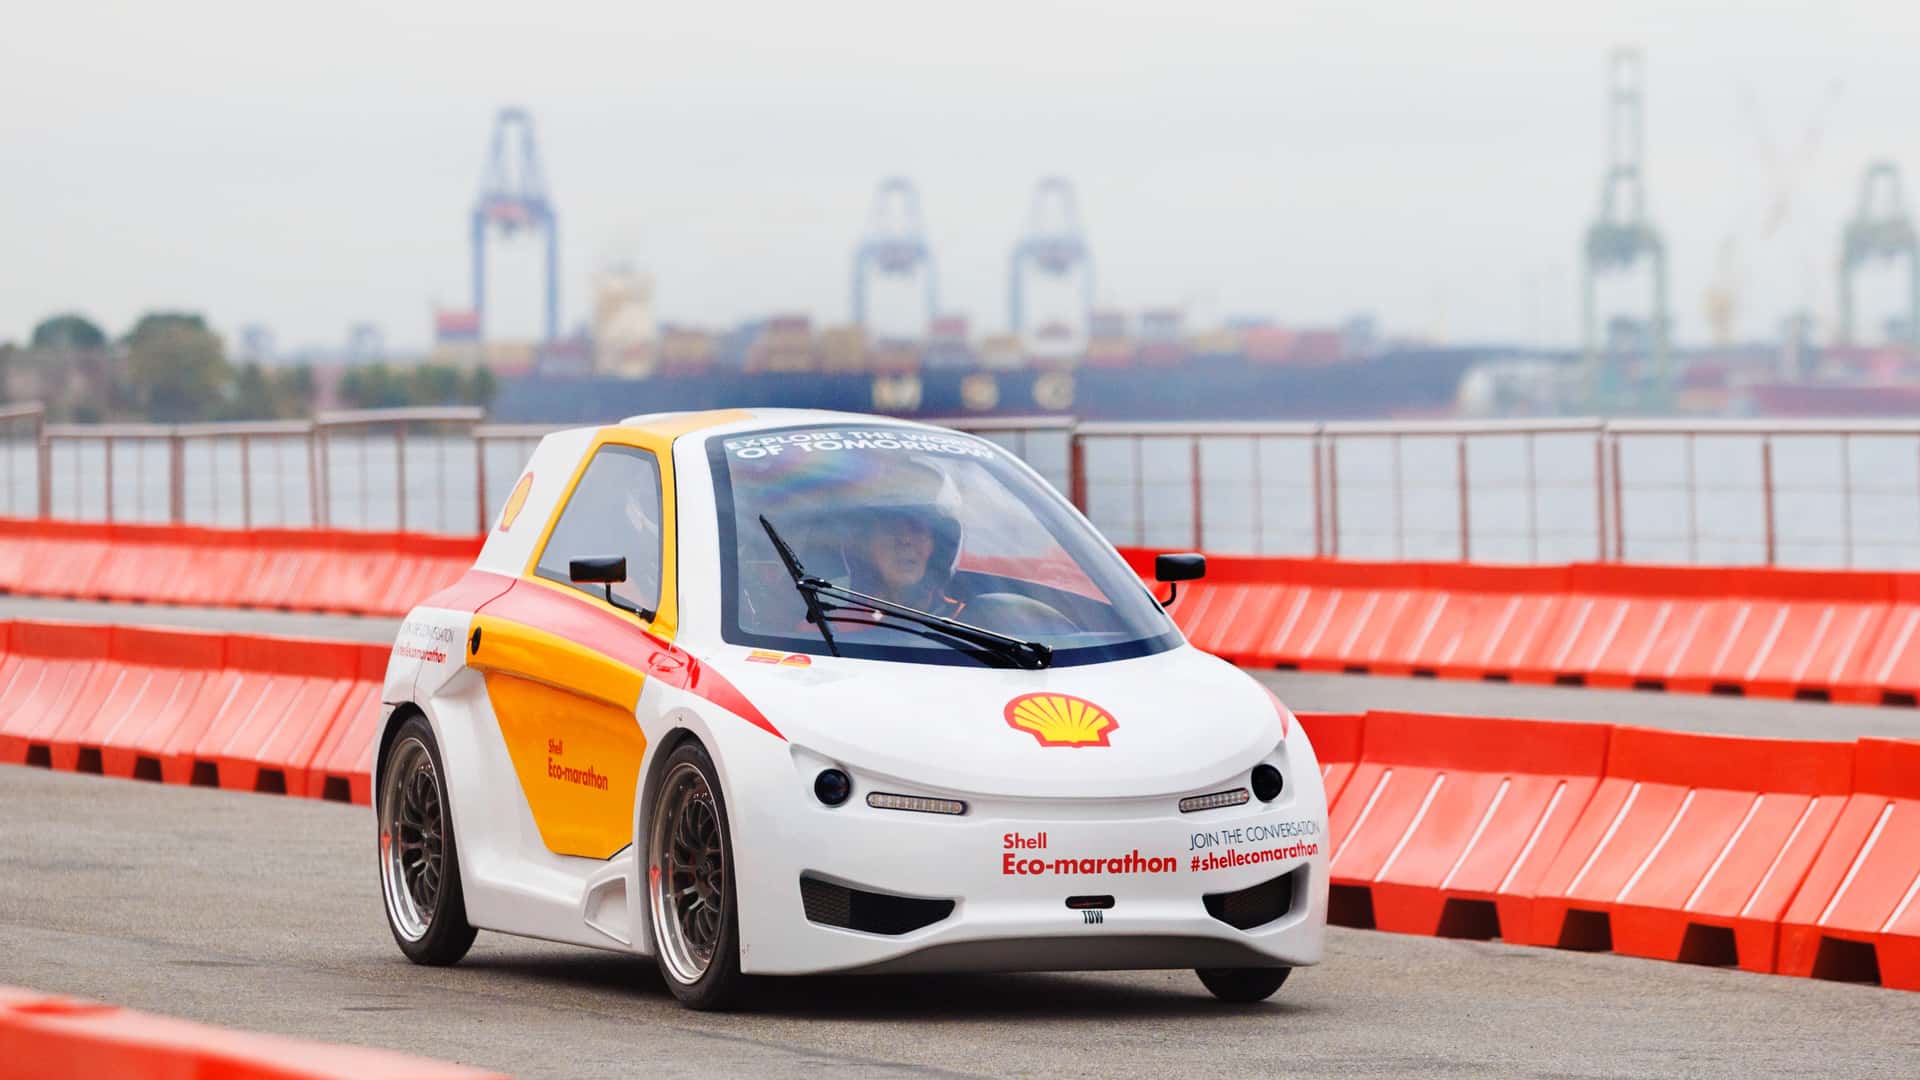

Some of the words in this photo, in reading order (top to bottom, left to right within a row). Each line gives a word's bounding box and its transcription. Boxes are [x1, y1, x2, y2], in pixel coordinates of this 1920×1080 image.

[725, 432, 843, 450] EXPLORE
[848, 431, 896, 441] THE
[736, 444, 783, 459] OF
[792, 439, 995, 459] TOMORROW
[548, 738, 563, 754] Shell
[548, 757, 608, 791] Eco-marathon
[1003, 832, 1047, 849] Shell
[1189, 831, 1219, 851] JOIN
[1221, 828, 1244, 845] THE
[1246, 820, 1320, 842] CONVERSATION
[1002, 849, 1177, 875] Eco-marathon
[1190, 840, 1318, 872] #shellecomarathon
[1081, 910, 1103, 925] TOW
